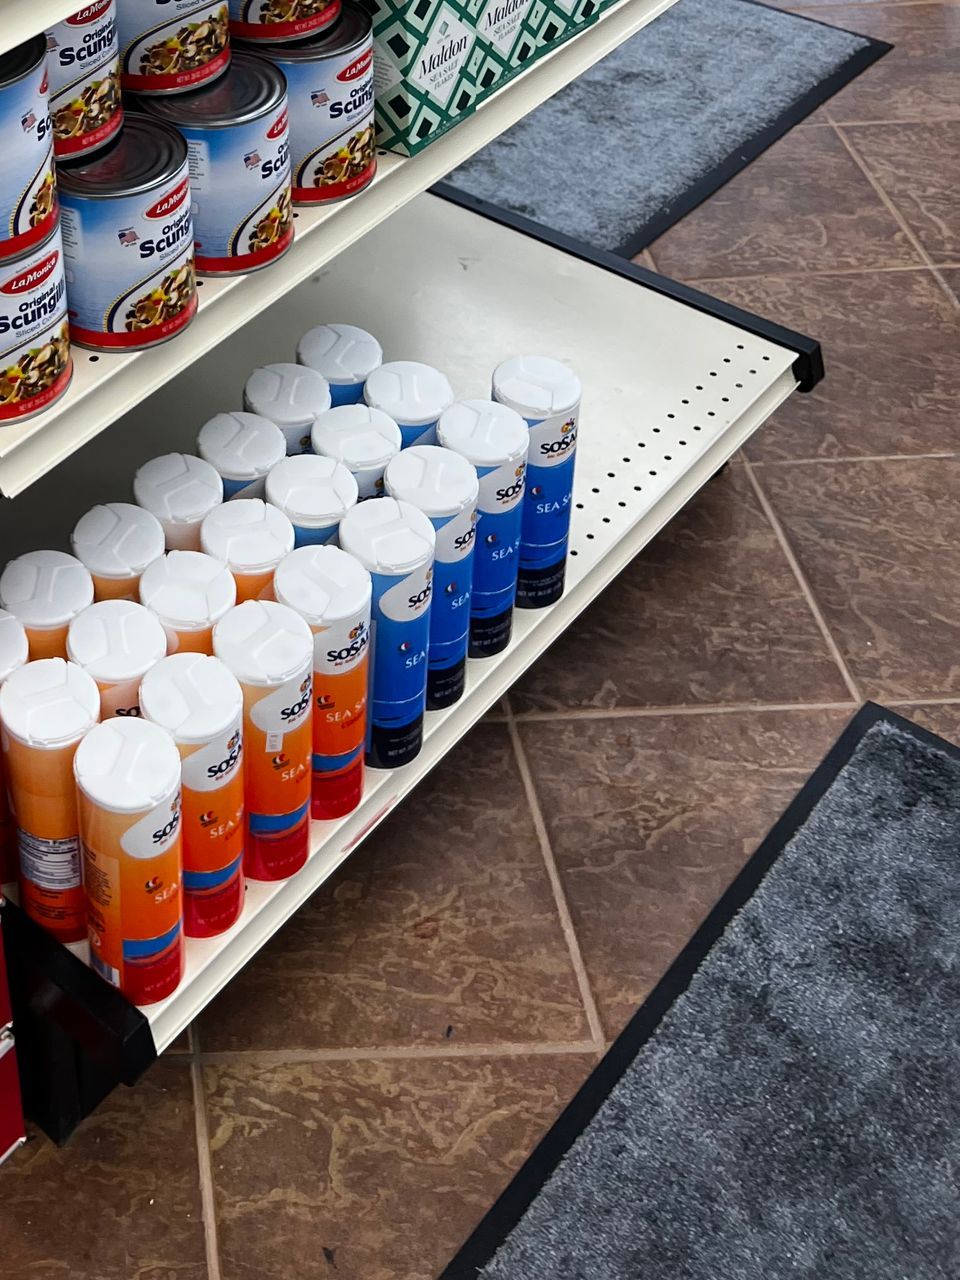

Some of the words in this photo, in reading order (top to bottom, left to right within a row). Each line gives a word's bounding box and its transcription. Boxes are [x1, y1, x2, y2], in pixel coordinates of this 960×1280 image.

[419, 35, 469, 80] Maldon
[18, 283, 57, 314] Original
[15, 322, 41, 338] Sliced
[536, 502, 561, 514] SEA
[491, 547, 515, 562] SEA
[451, 591, 471, 610] SEA
[405, 649, 427, 670] SEA
[326, 709, 353, 724] SEA
[281, 763, 306, 782] SEA
[209, 820, 235, 839] SEA
[155, 881, 178, 904] SEA
